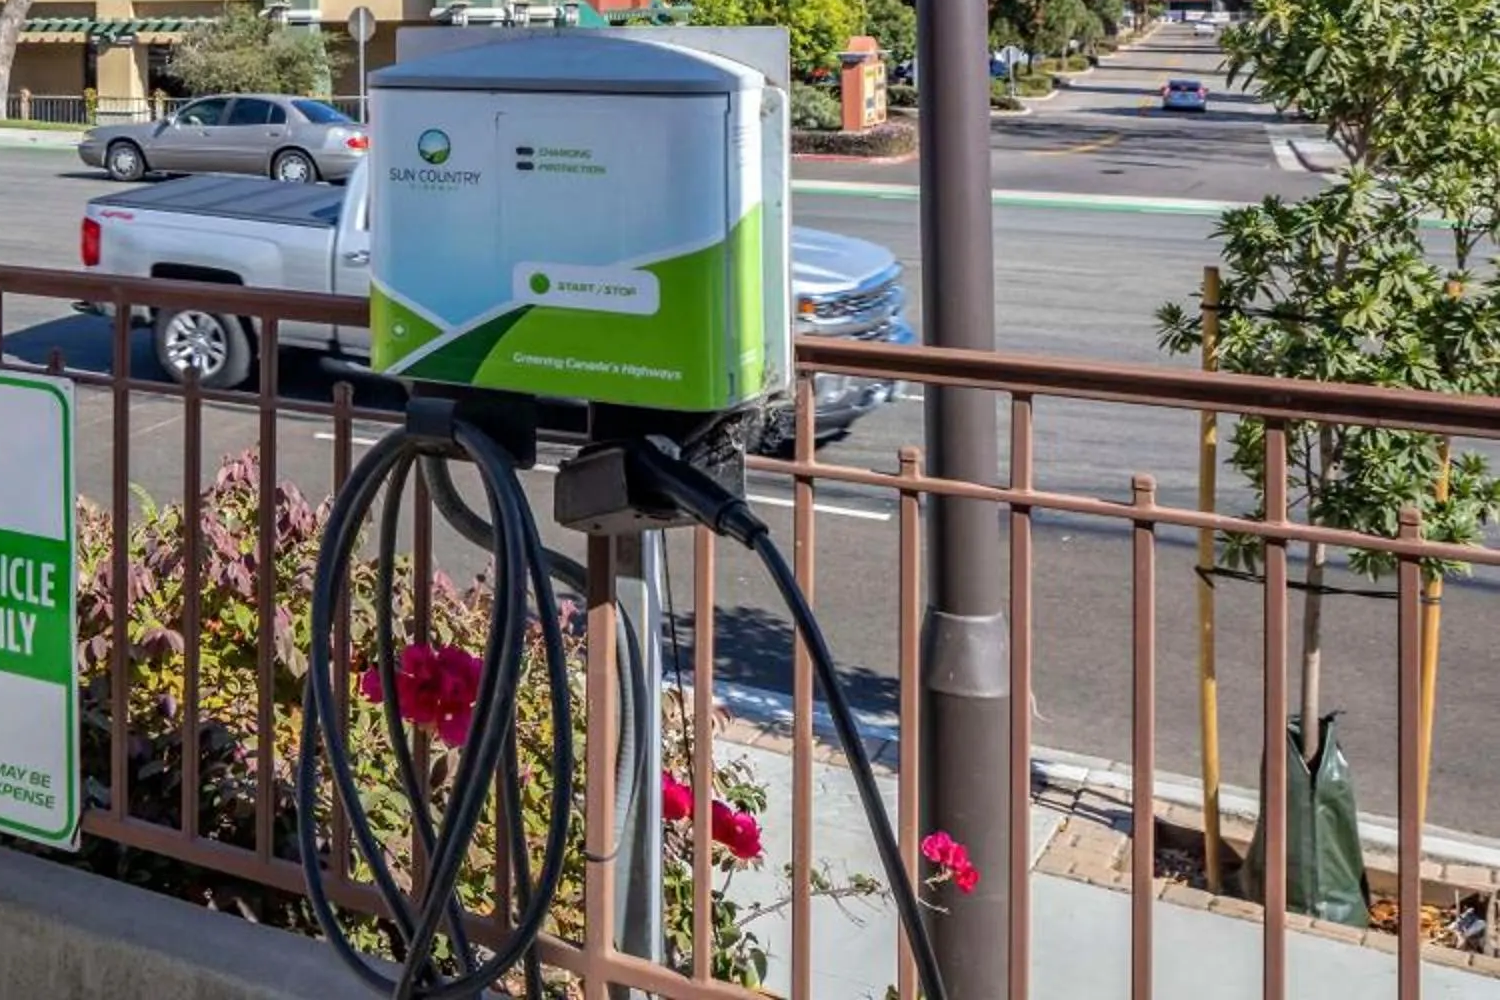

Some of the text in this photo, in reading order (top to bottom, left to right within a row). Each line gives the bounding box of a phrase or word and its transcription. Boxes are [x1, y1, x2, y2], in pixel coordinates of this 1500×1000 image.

[389, 167, 482, 186] SUN COUNTRY
[513, 352, 684, 381] Greening Canada's Highways
[29, 770, 52, 789] BE
